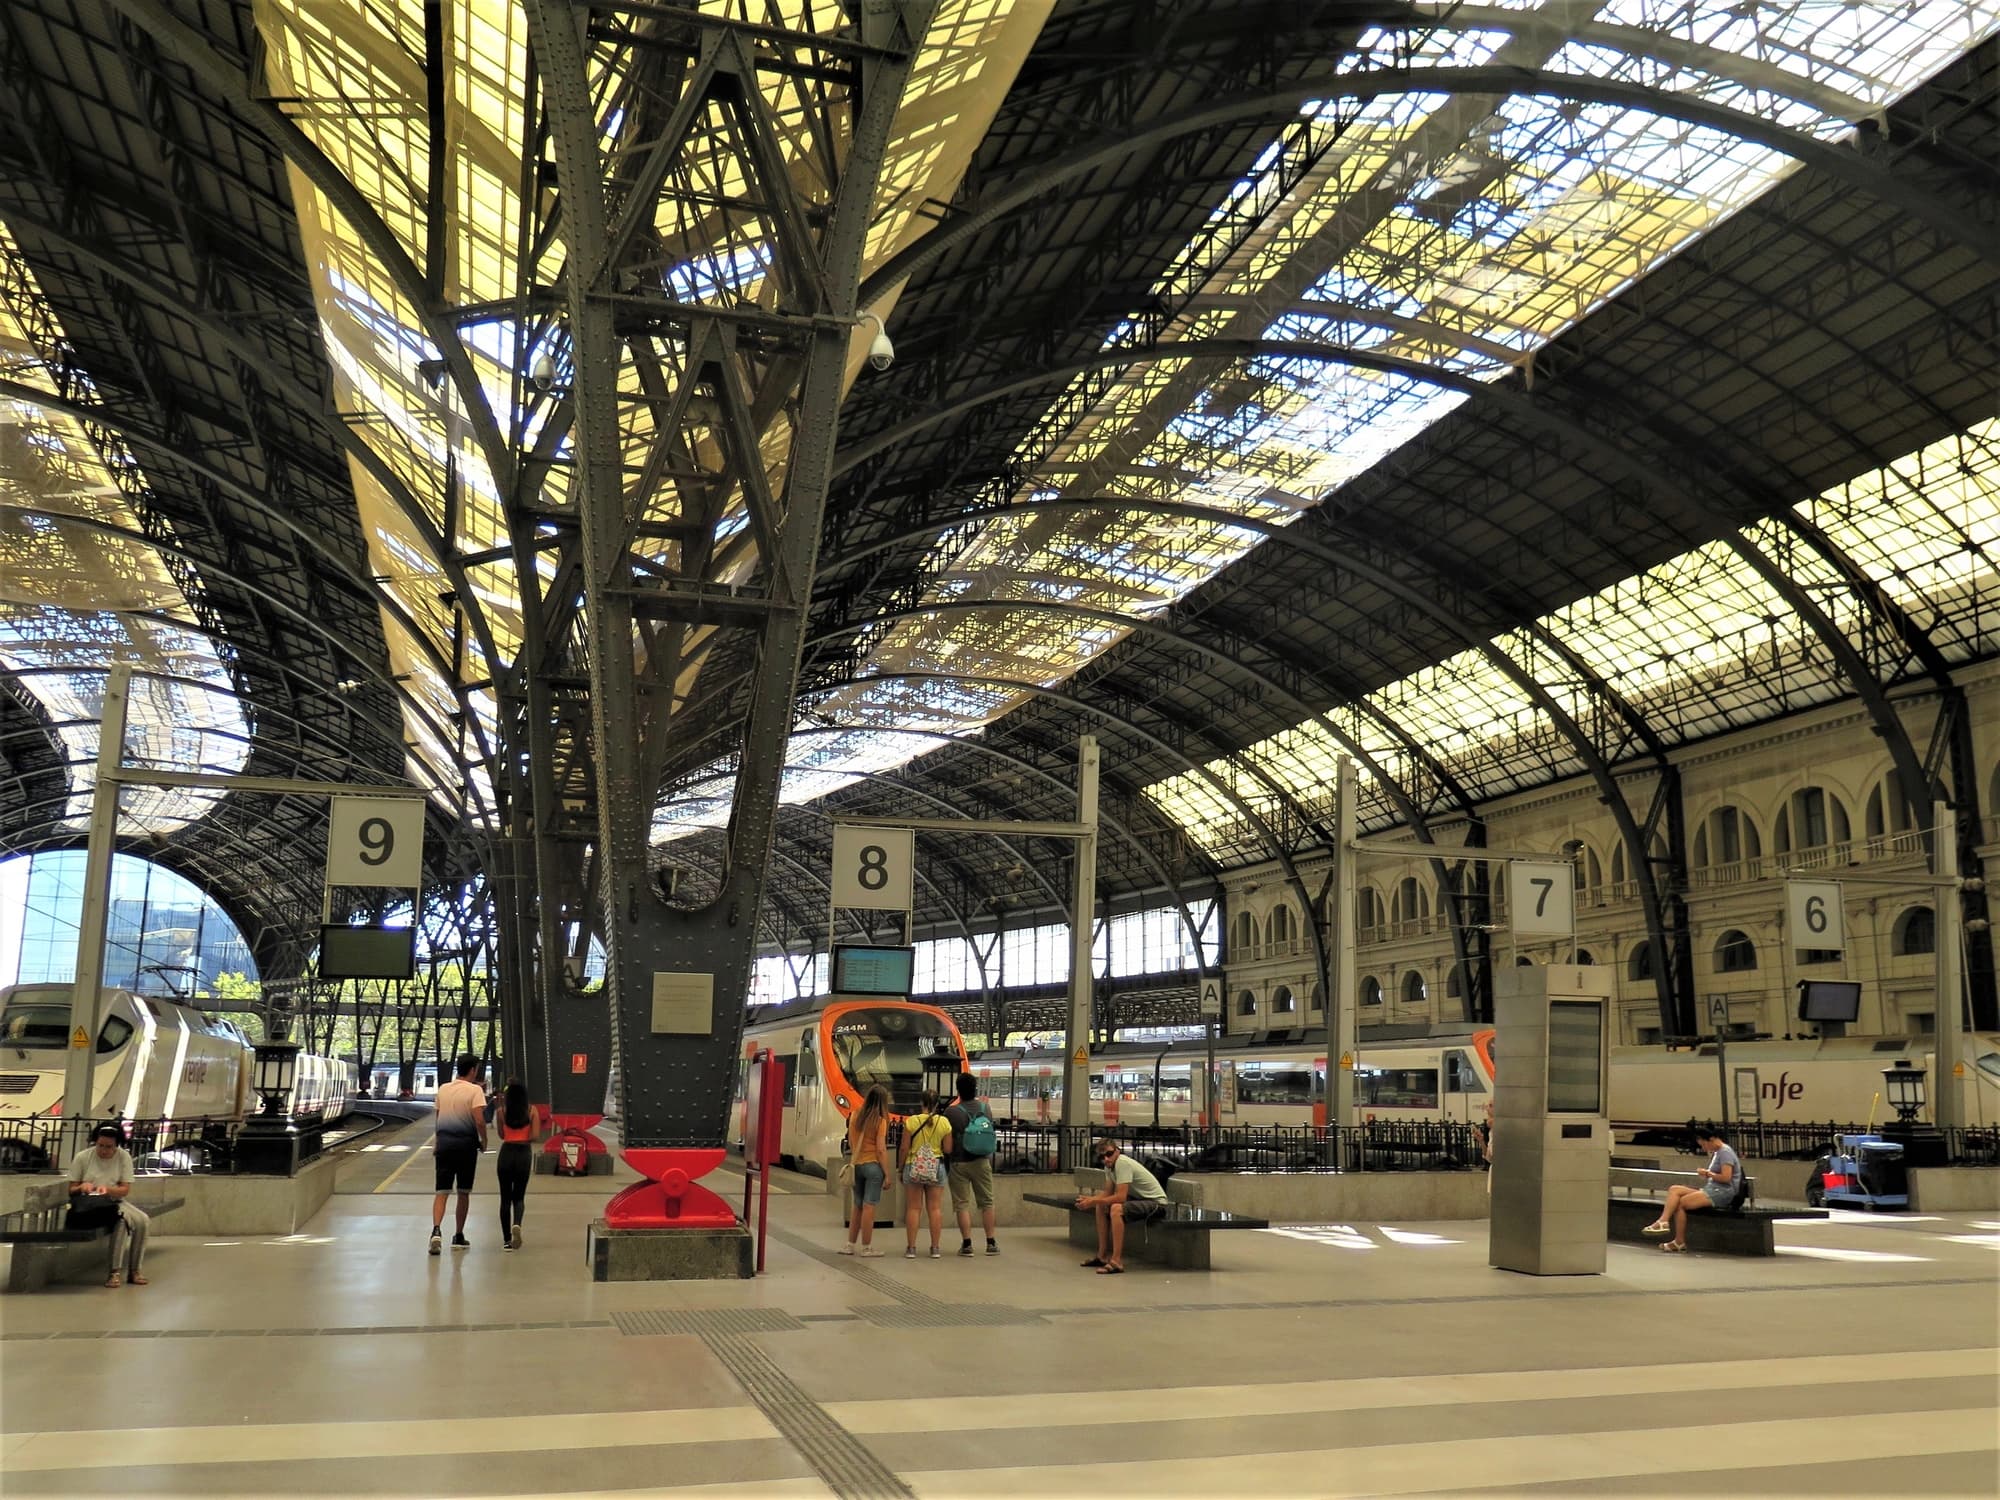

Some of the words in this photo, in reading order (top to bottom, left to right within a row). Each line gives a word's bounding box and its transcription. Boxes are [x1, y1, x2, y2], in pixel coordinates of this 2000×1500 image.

[358, 817, 395, 866] 9
[857, 845, 889, 891] 8
[1529, 877, 1554, 918] 7
[1805, 895, 1828, 934] 6
[1203, 983, 1218, 1001] A
[1712, 998, 1725, 1015] A
[836, 1024, 867, 1034] 244M
[1761, 1071, 1804, 1110] nfe
